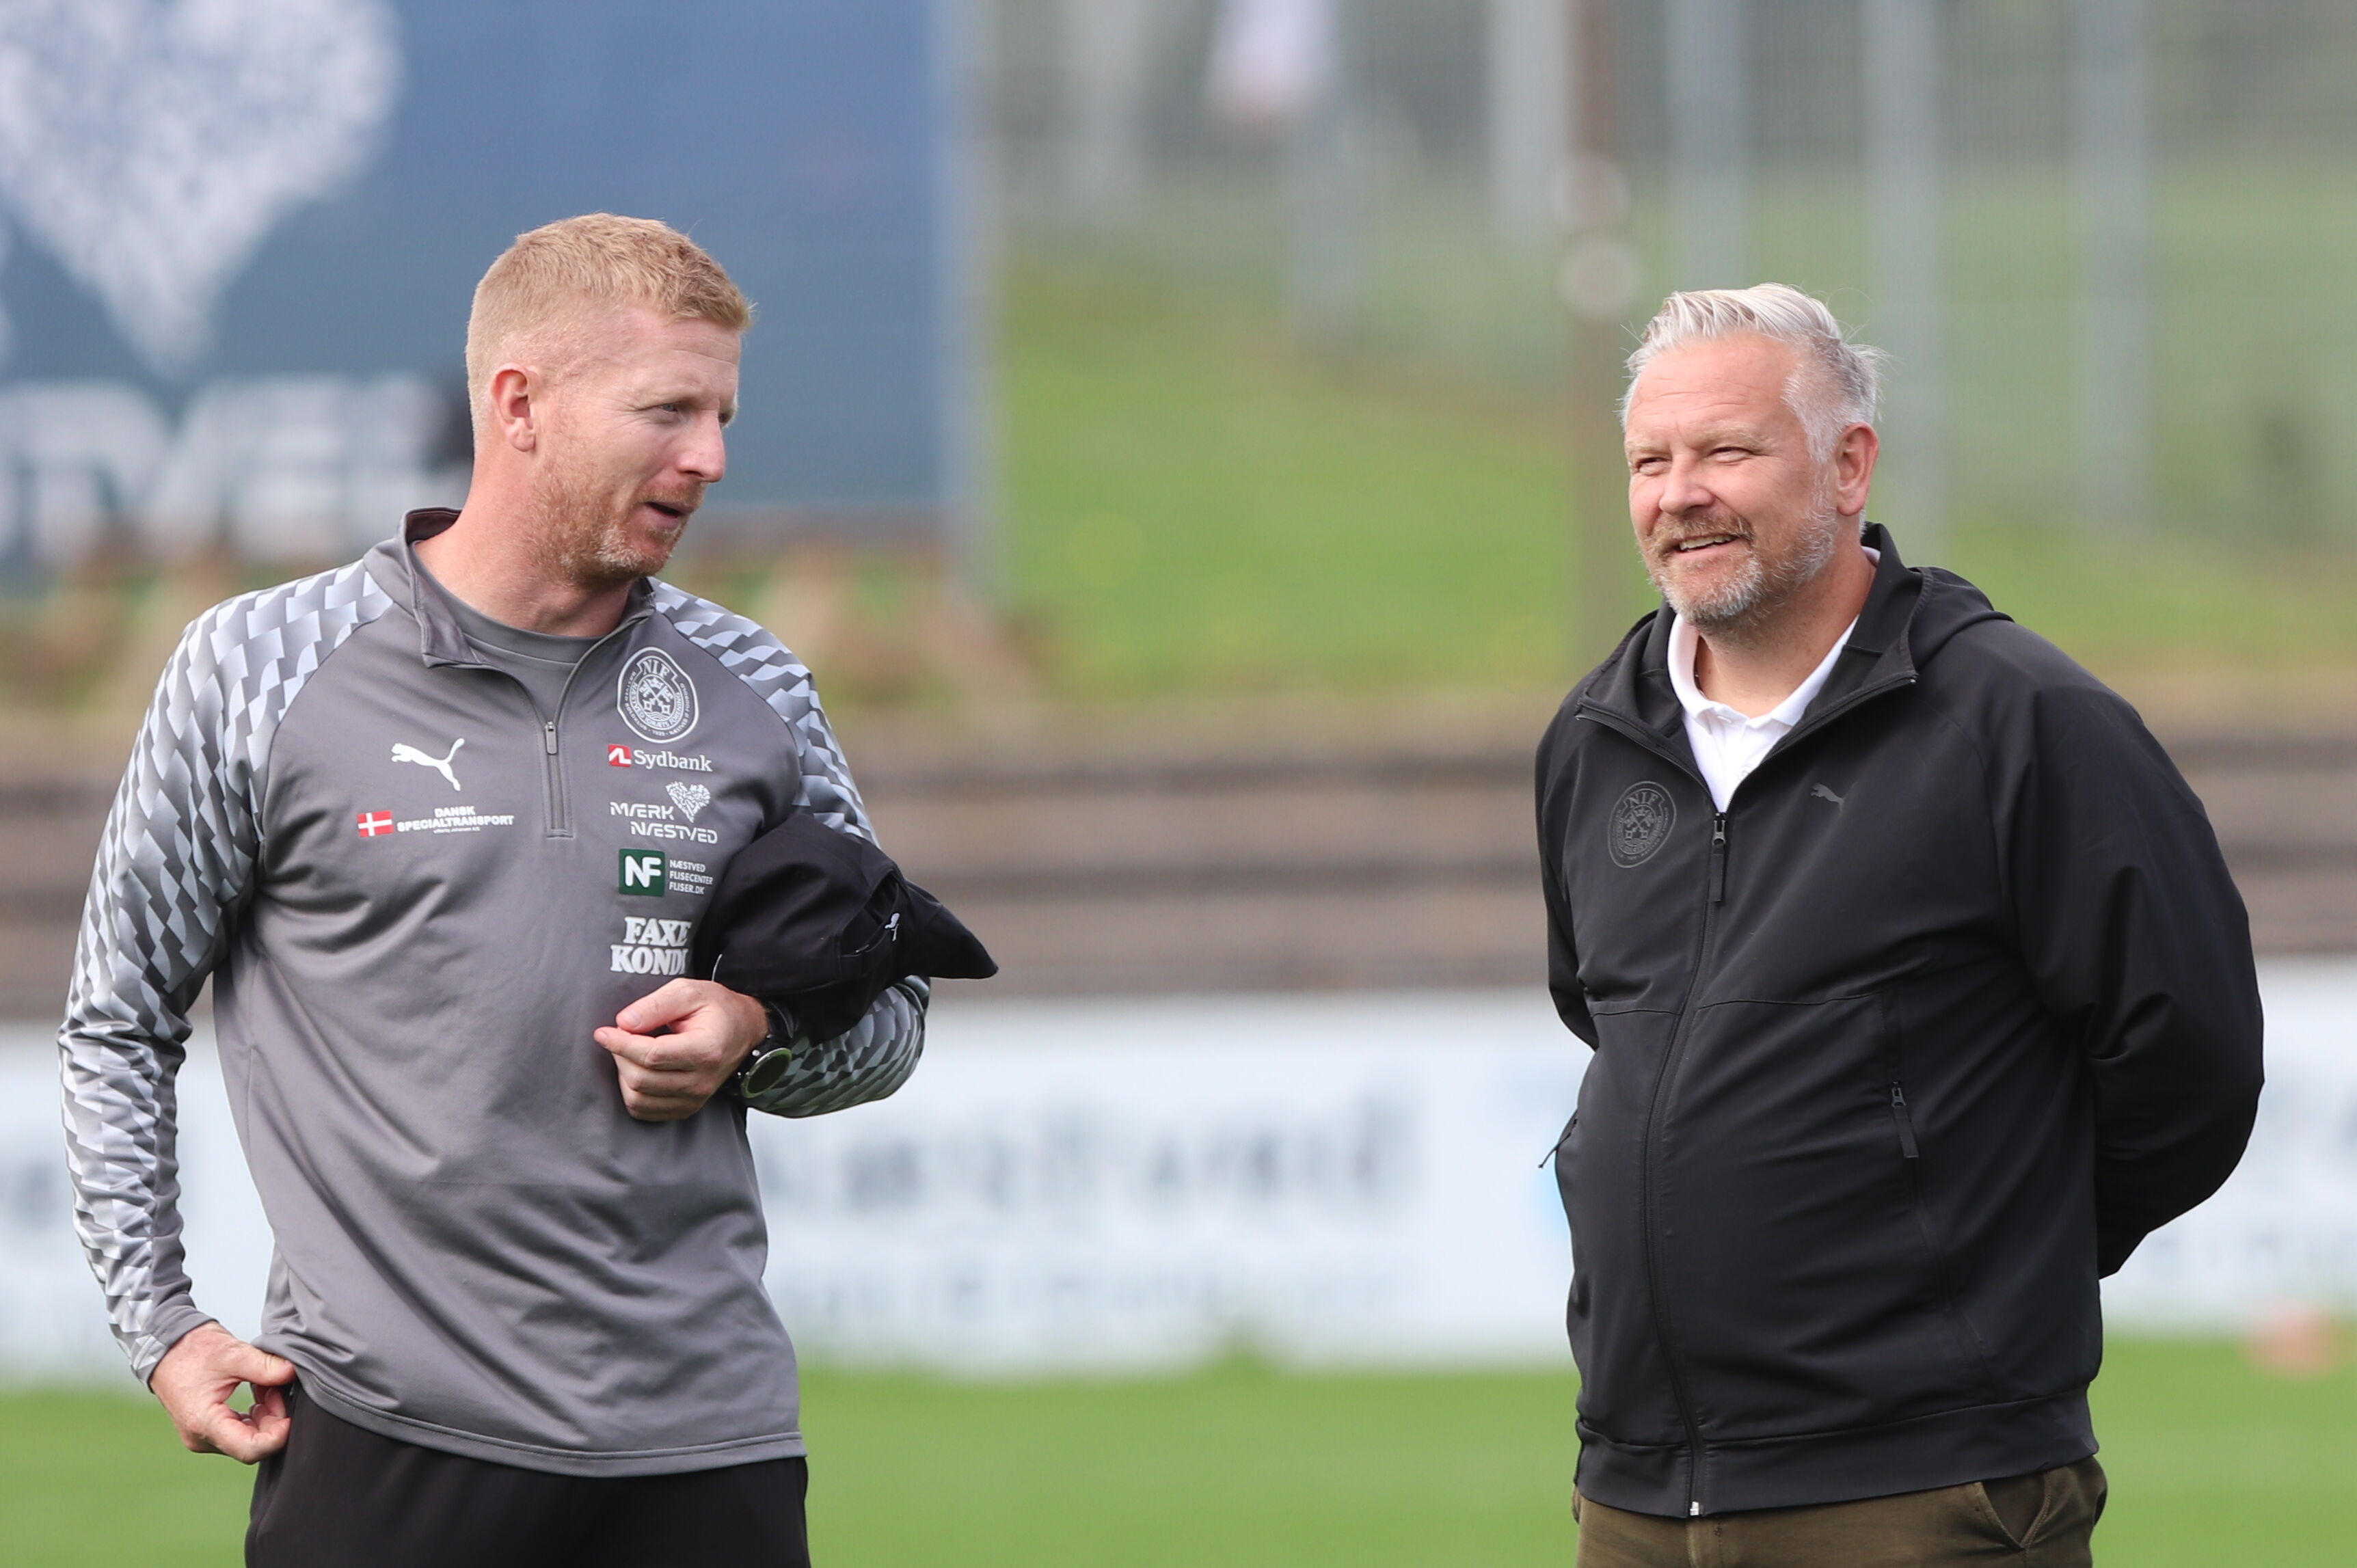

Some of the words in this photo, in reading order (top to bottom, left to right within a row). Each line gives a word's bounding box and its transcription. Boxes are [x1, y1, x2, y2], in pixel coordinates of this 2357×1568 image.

[642, 659, 670, 678] NIF
[633, 749, 713, 772] Sydbank
[1628, 792, 1659, 808] NIF
[434, 806, 476, 817] DANSK
[610, 802, 674, 820] MÆRK
[396, 815, 514, 832] SPECIALTRANSPORT
[630, 821, 718, 844] NÆSTVED
[625, 855, 661, 887] NF
[669, 859, 706, 872] NÆSTVED
[669, 871, 713, 884] FLISECENTER
[669, 882, 705, 894] FLISER.DK
[623, 916, 692, 947] FAXE
[610, 944, 688, 976] KONDI
